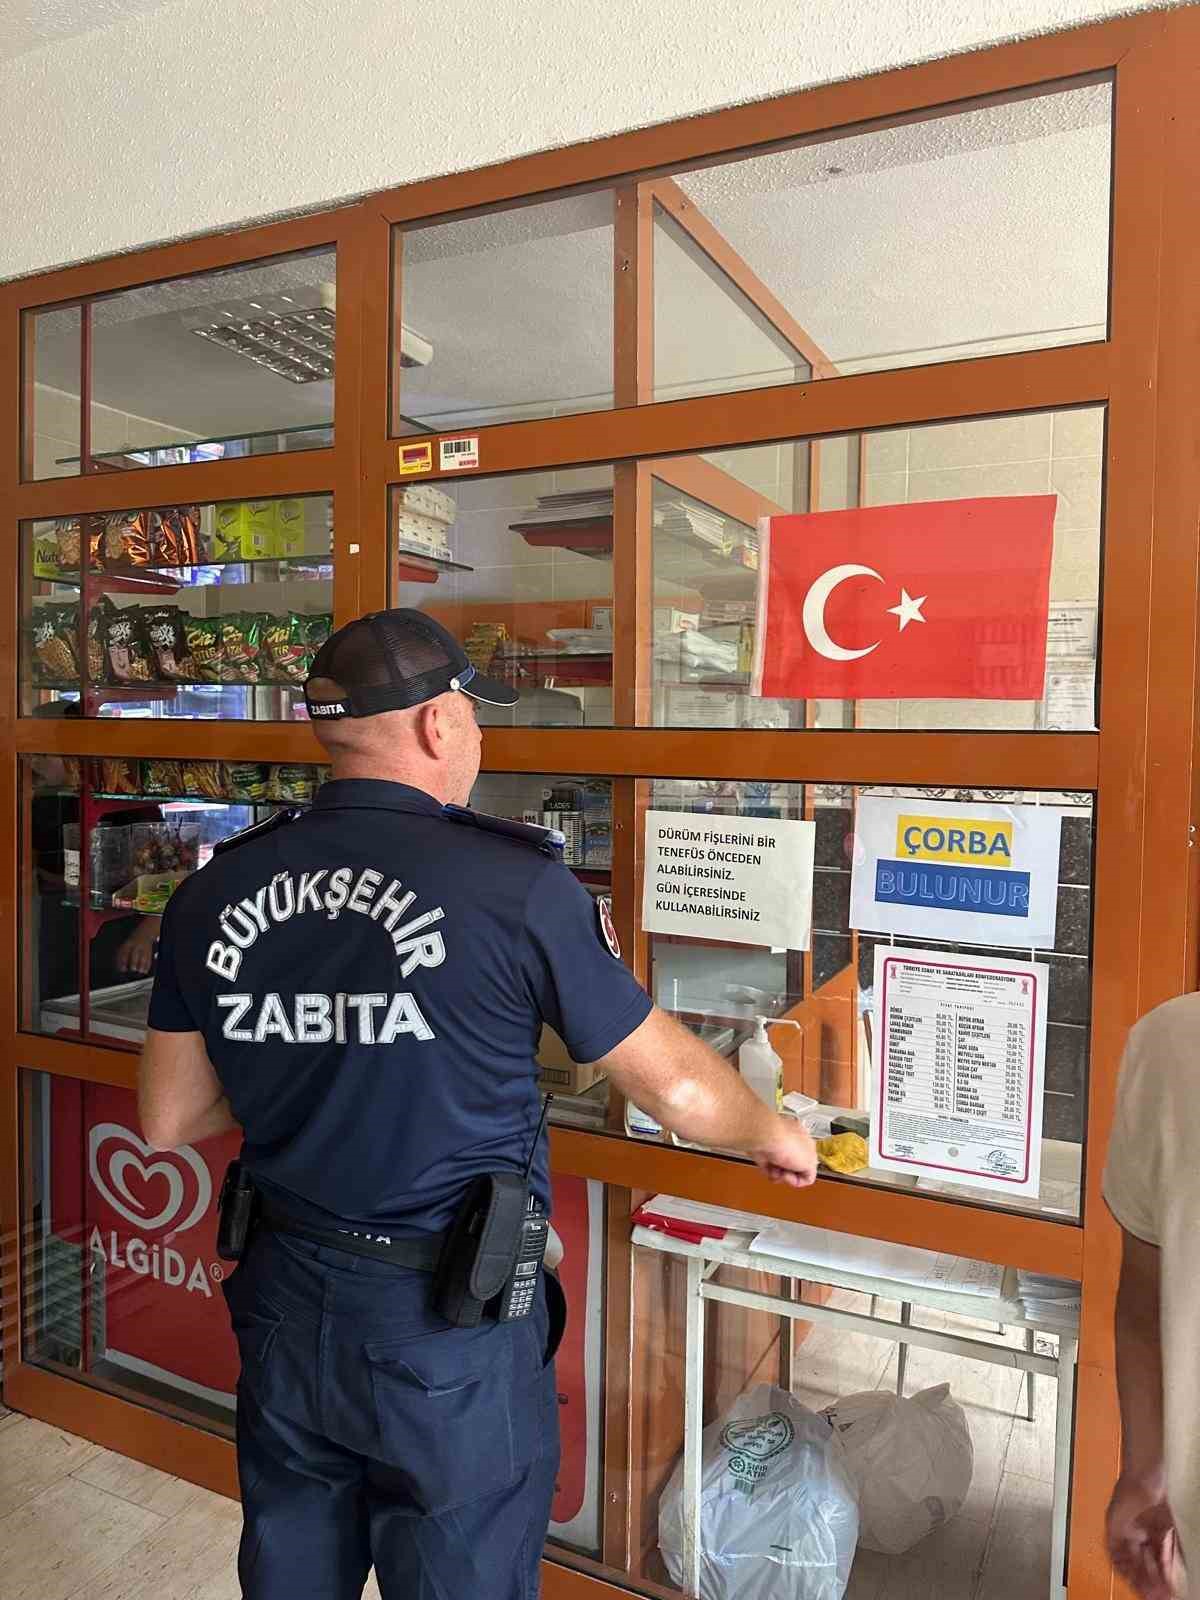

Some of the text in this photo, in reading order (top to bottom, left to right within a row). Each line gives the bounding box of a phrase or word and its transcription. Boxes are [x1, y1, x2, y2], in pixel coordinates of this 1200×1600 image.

[658, 827, 776, 848] DÜRÜM FİŞLERİNİ BİR
[904, 826, 1011, 857] ÇORBA
[658, 846, 761, 865] TENEFÜS ÖNCEDEN
[657, 864, 735, 881] ALABİLİRSİNİZ.
[656, 882, 746, 902] GÜN İÇERESİNDE
[877, 869, 1028, 908] BULUNUR
[655, 900, 760, 922] KULLANABİLİRSİNİZ
[206, 867, 446, 982] BÜYÜKŞEHİR
[216, 993, 436, 1044] ZABITA
